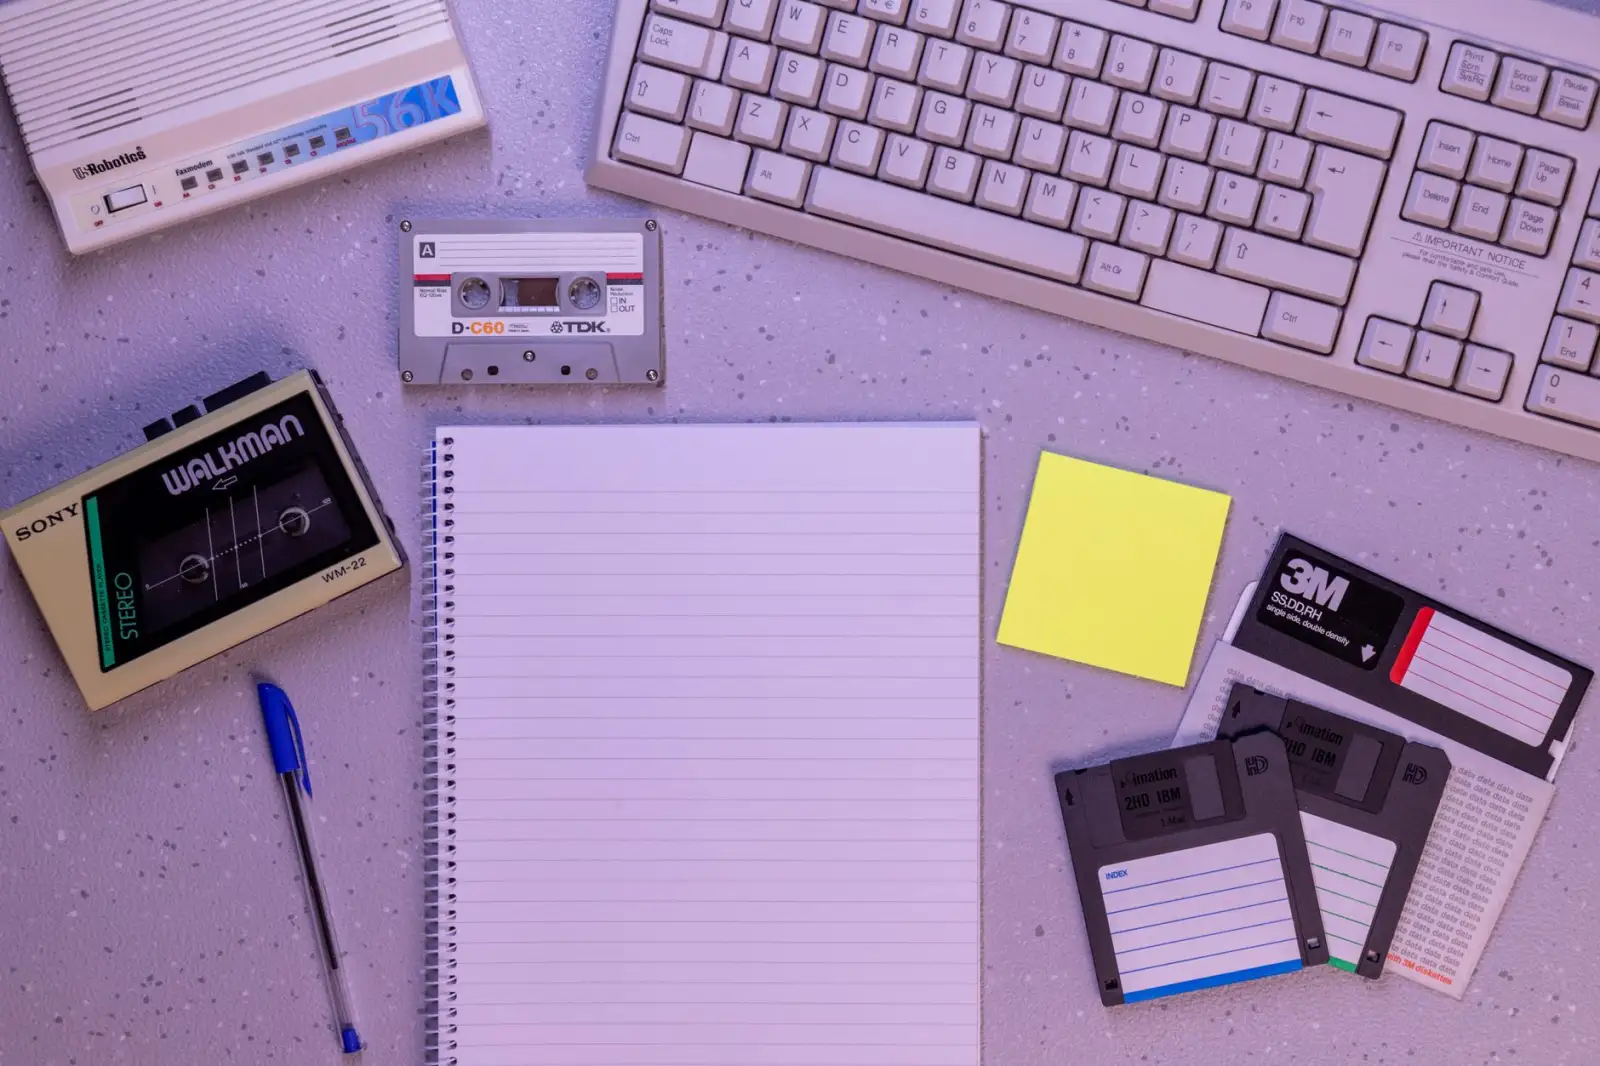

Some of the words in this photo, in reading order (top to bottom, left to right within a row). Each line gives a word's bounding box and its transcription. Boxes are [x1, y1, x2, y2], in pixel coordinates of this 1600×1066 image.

[789, 5, 802, 20] W
[1240, 1, 1252, 11] F9
[920, 8, 928, 19] 5
[1289, 14, 1305, 26] F10
[653, 24, 673, 36] Caps
[837, 19, 849, 34] E
[968, 22, 976, 32] 6
[1338, 28, 1352, 39] F11
[650, 35, 670, 47] Lock
[886, 33, 899, 47] R
[1018, 35, 1027, 45] 7
[1388, 41, 1403, 52] F12
[739, 46, 749, 60] A
[938, 47, 948, 60] T
[1068, 49, 1075, 59] 8
[1464, 50, 1485, 62] Print
[788, 60, 799, 74] S
[986, 60, 997, 74] Y
[1117, 62, 1125, 72] 9
[1460, 60, 1480, 71] Scrn
[836, 73, 849, 87] D
[1034, 73, 1046, 87] U
[1513, 69, 1538, 83] Scroll
[1510, 81, 1530, 93] Lock
[1564, 78, 1588, 92] Pause
[885, 86, 895, 99] F
[750, 103, 761, 117] Z
[935, 100, 947, 114] G
[1558, 98, 1581, 111] Break
[798, 116, 811, 131] X
[983, 114, 996, 128] H
[1180, 113, 1191, 126] P
[625, 132, 640, 143] Ctrl
[848, 130, 861, 143] C
[1033, 128, 1042, 141] J
[898, 143, 910, 157] V
[1080, 140, 1093, 155] K
[1438, 141, 1461, 154] Insert
[175, 160, 213, 176] Faxmodem
[945, 156, 957, 170] B
[1129, 154, 1139, 168] L
[1487, 154, 1512, 168] Home
[1539, 161, 1560, 174] Page
[760, 170, 772, 180] Alt
[993, 169, 1007, 185] N
[1536, 171, 1547, 183] Up
[1042, 182, 1057, 198] M
[1423, 189, 1450, 204] Delete
[1472, 202, 1490, 215] End
[1523, 211, 1544, 224] Page
[1519, 222, 1544, 234] Down
[422, 244, 433, 256] A
[1424, 235, 1484, 257] IMPORTANT
[1487, 251, 1527, 270] NOTICE
[1581, 277, 1591, 290] 4
[1282, 312, 1298, 324] Ctrl
[452, 321, 504, 335] D-C60
[563, 321, 606, 333] TDK
[1568, 326, 1573, 338] 1
[1560, 347, 1577, 359] End
[1550, 375, 1560, 387] 0
[161, 414, 305, 495] WALKMAN
[15, 502, 81, 542] SONY
[321, 557, 367, 584] WM-22
[1280, 558, 1350, 612] 3M
[115, 572, 138, 640] STEREO
[1271, 591, 1322, 621] SS,DD,RH
[1266, 604, 1286, 617] single
[1286, 613, 1301, 624] side,
[1302, 619, 1325, 635] double
[1325, 630, 1350, 647] density
[1299, 721, 1343, 746] imation
[1311, 747, 1336, 767] IBM
[1245, 755, 1268, 776] HD
[1132, 767, 1177, 786] imation
[1402, 763, 1427, 785] HD
[1125, 793, 1150, 810] 2HD
[1157, 787, 1181, 804] IBM
[1105, 869, 1128, 880] INDEX
